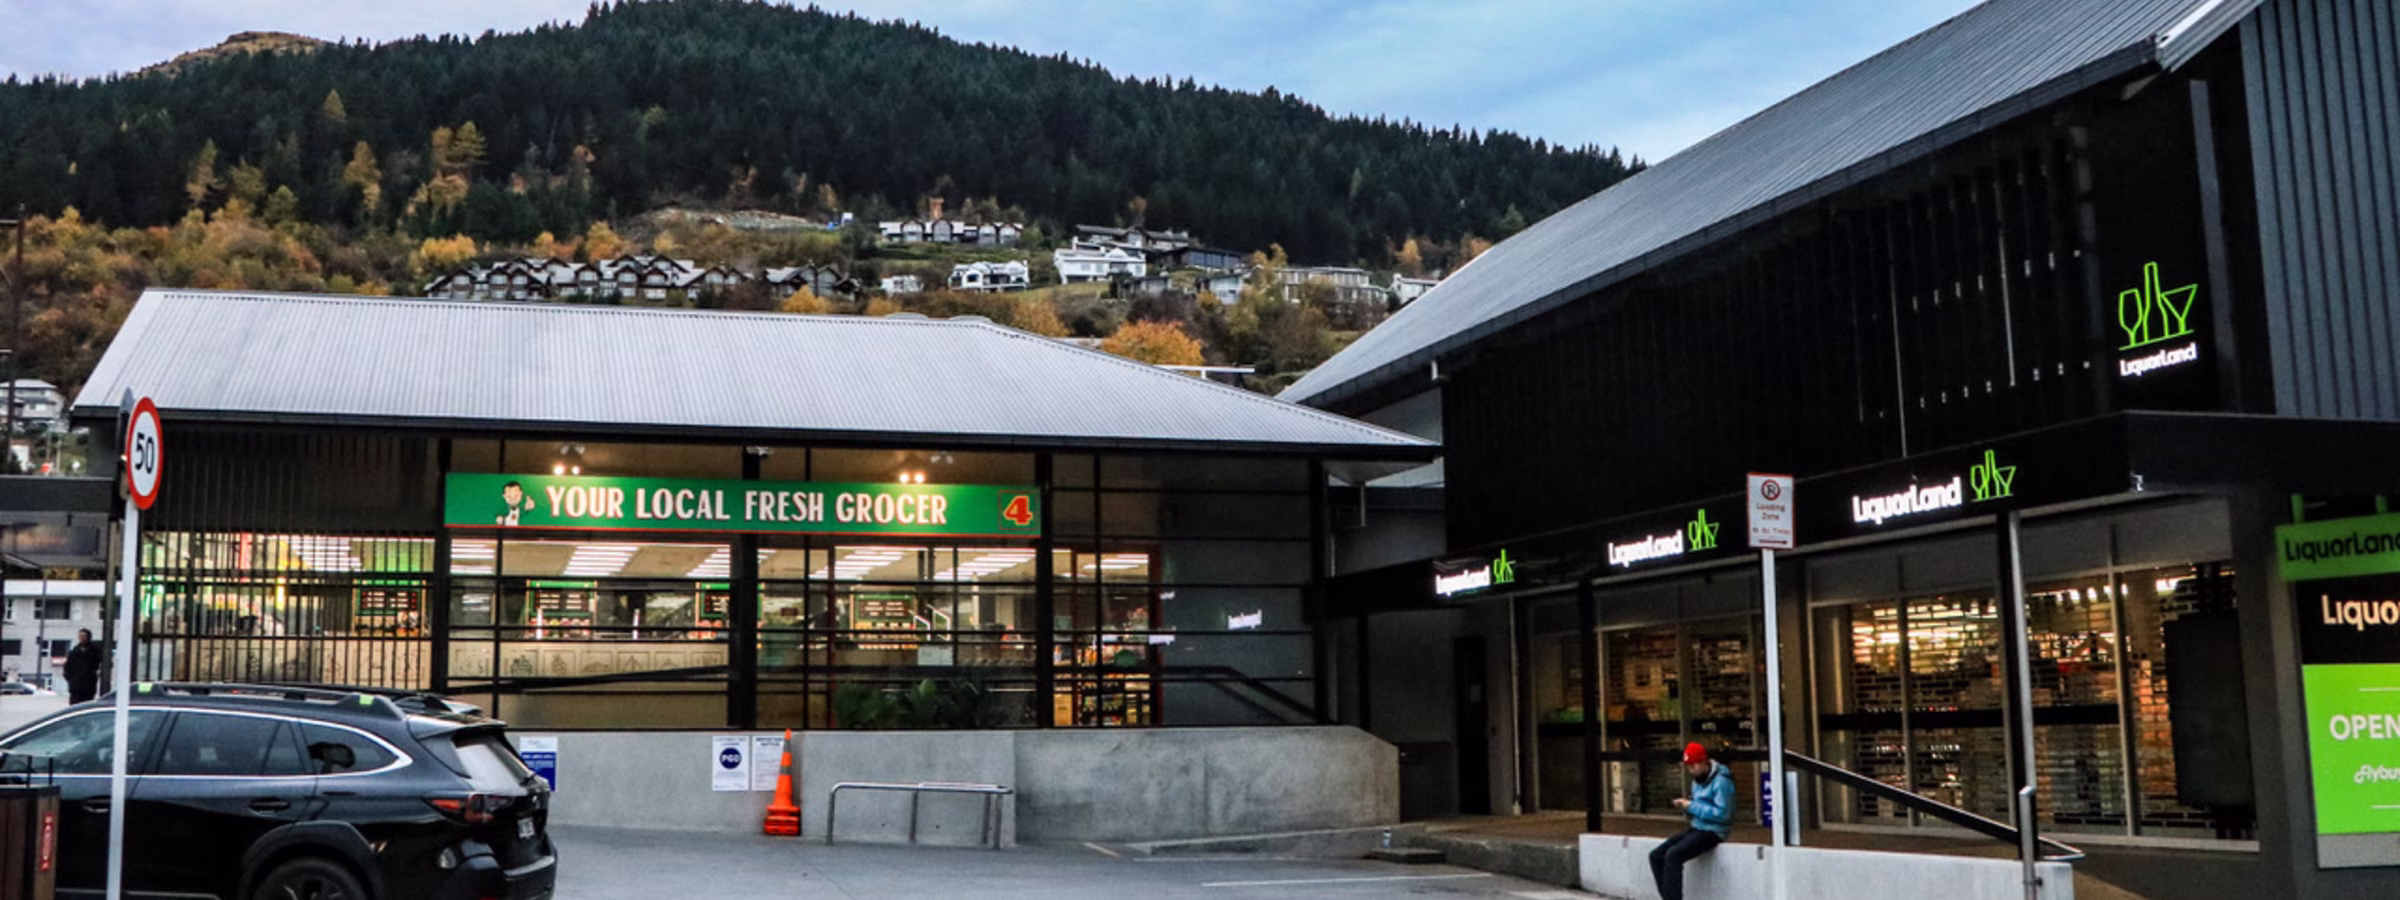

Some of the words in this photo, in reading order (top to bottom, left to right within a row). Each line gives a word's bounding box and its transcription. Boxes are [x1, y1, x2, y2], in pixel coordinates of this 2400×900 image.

[135, 431, 154, 475] 50
[546, 485, 625, 518] YOUR
[635, 487, 732, 520] LOCAL
[744, 490, 824, 522] FRESH
[835, 493, 947, 525] GROCER
[1003, 494, 1033, 525] 4
[2321, 594, 2400, 631] Liquo
[2330, 714, 2400, 741] OPEN
